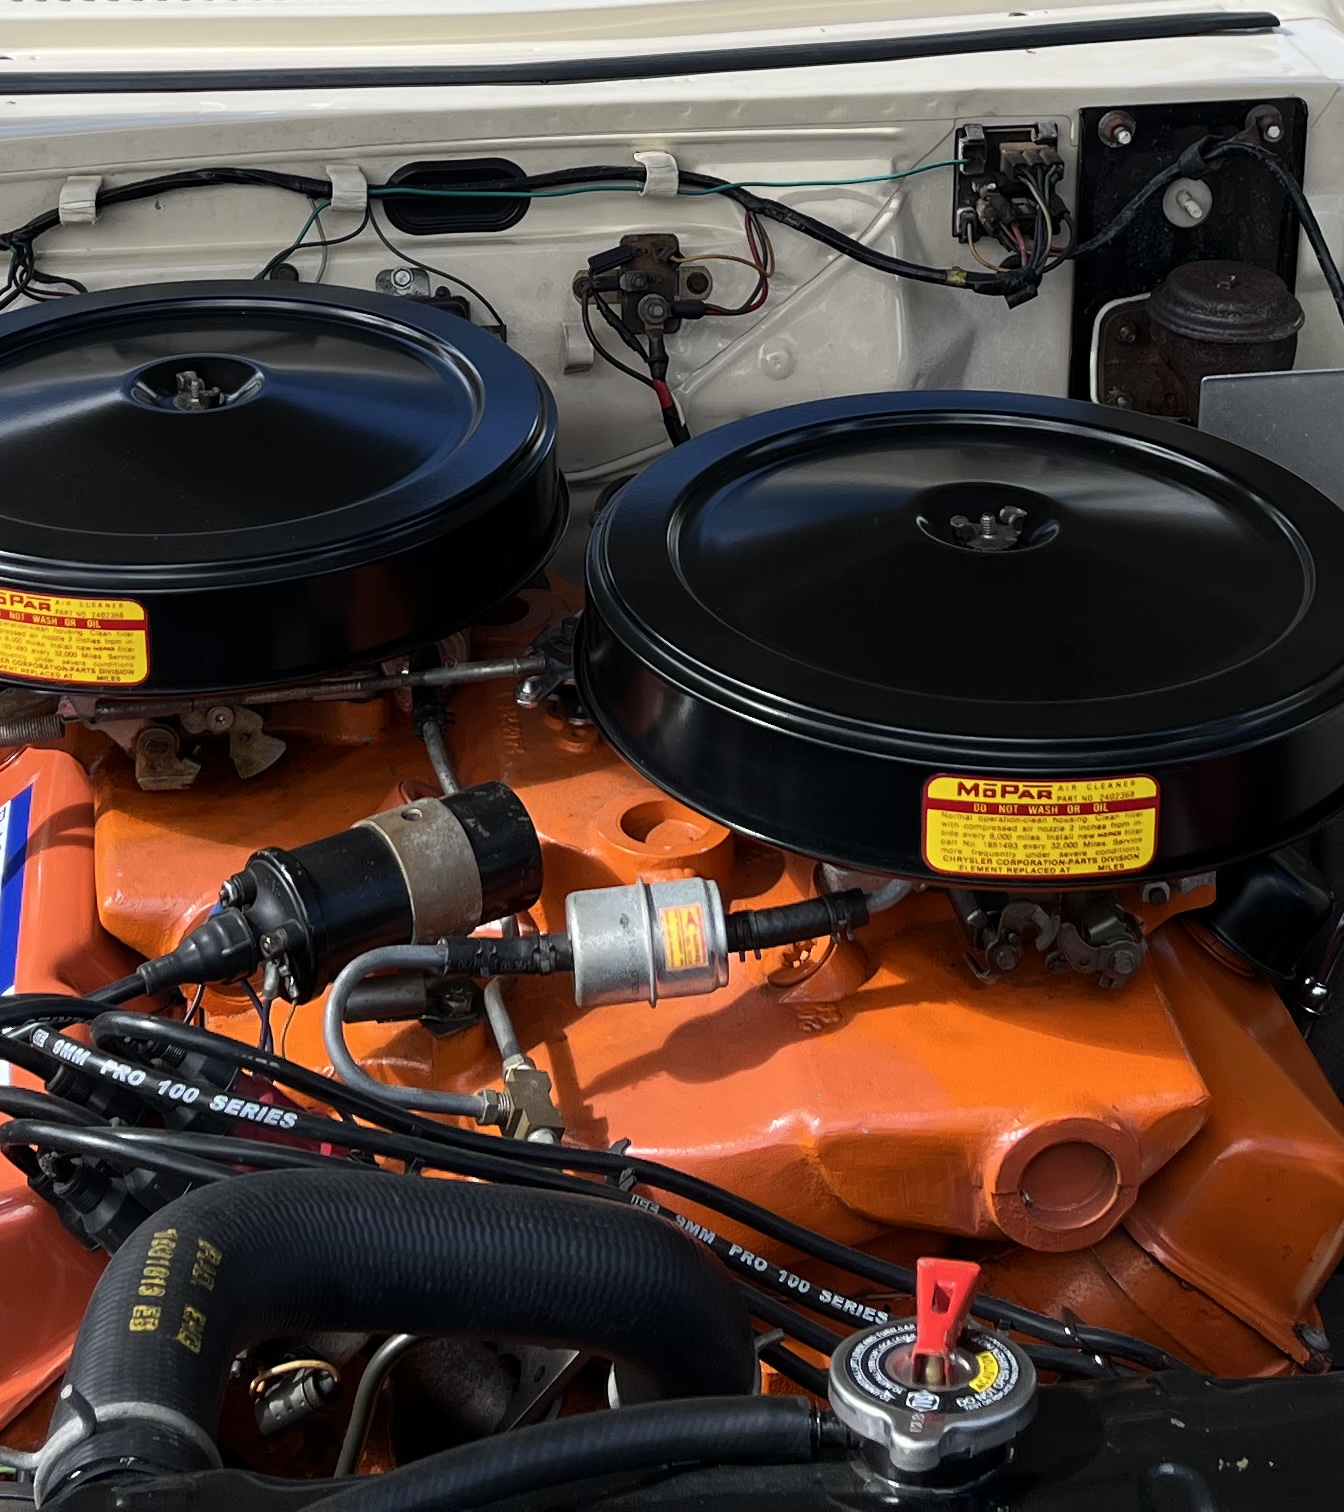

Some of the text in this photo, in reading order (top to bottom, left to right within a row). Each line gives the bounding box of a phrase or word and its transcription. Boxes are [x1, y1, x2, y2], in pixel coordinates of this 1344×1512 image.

[9, 610, 25, 620] NOT
[32, 614, 57, 624] WASH
[64, 617, 76, 626] OR
[87, 619, 101, 628] OIL
[1057, 784, 1077, 792] AIR
[1086, 779, 1135, 791] CLEANER
[1099, 791, 1135, 801] 2402368
[973, 802, 1109, 815] DO NOT WASH OR OIL
[941, 811, 973, 821] Normal
[1095, 812, 1120, 821] Clean
[963, 823, 1017, 832] compressed
[1111, 820, 1130, 829] from
[963, 832, 986, 840] every
[1095, 846, 1140, 856] conditions
[943, 854, 993, 865] CHRYSLER
[1101, 853, 1140, 863] DIVISION
[959, 865, 1002, 873] ELEMENT
[1098, 863, 1124, 871] MILES
[52, 1039, 298, 1129] 9MM PRO 100 SERIES
[676, 1214, 889, 1325] 9MM PRO 100 SERIES
[956, 1395, 976, 1408] DO
[975, 1387, 997, 1402] NOT
